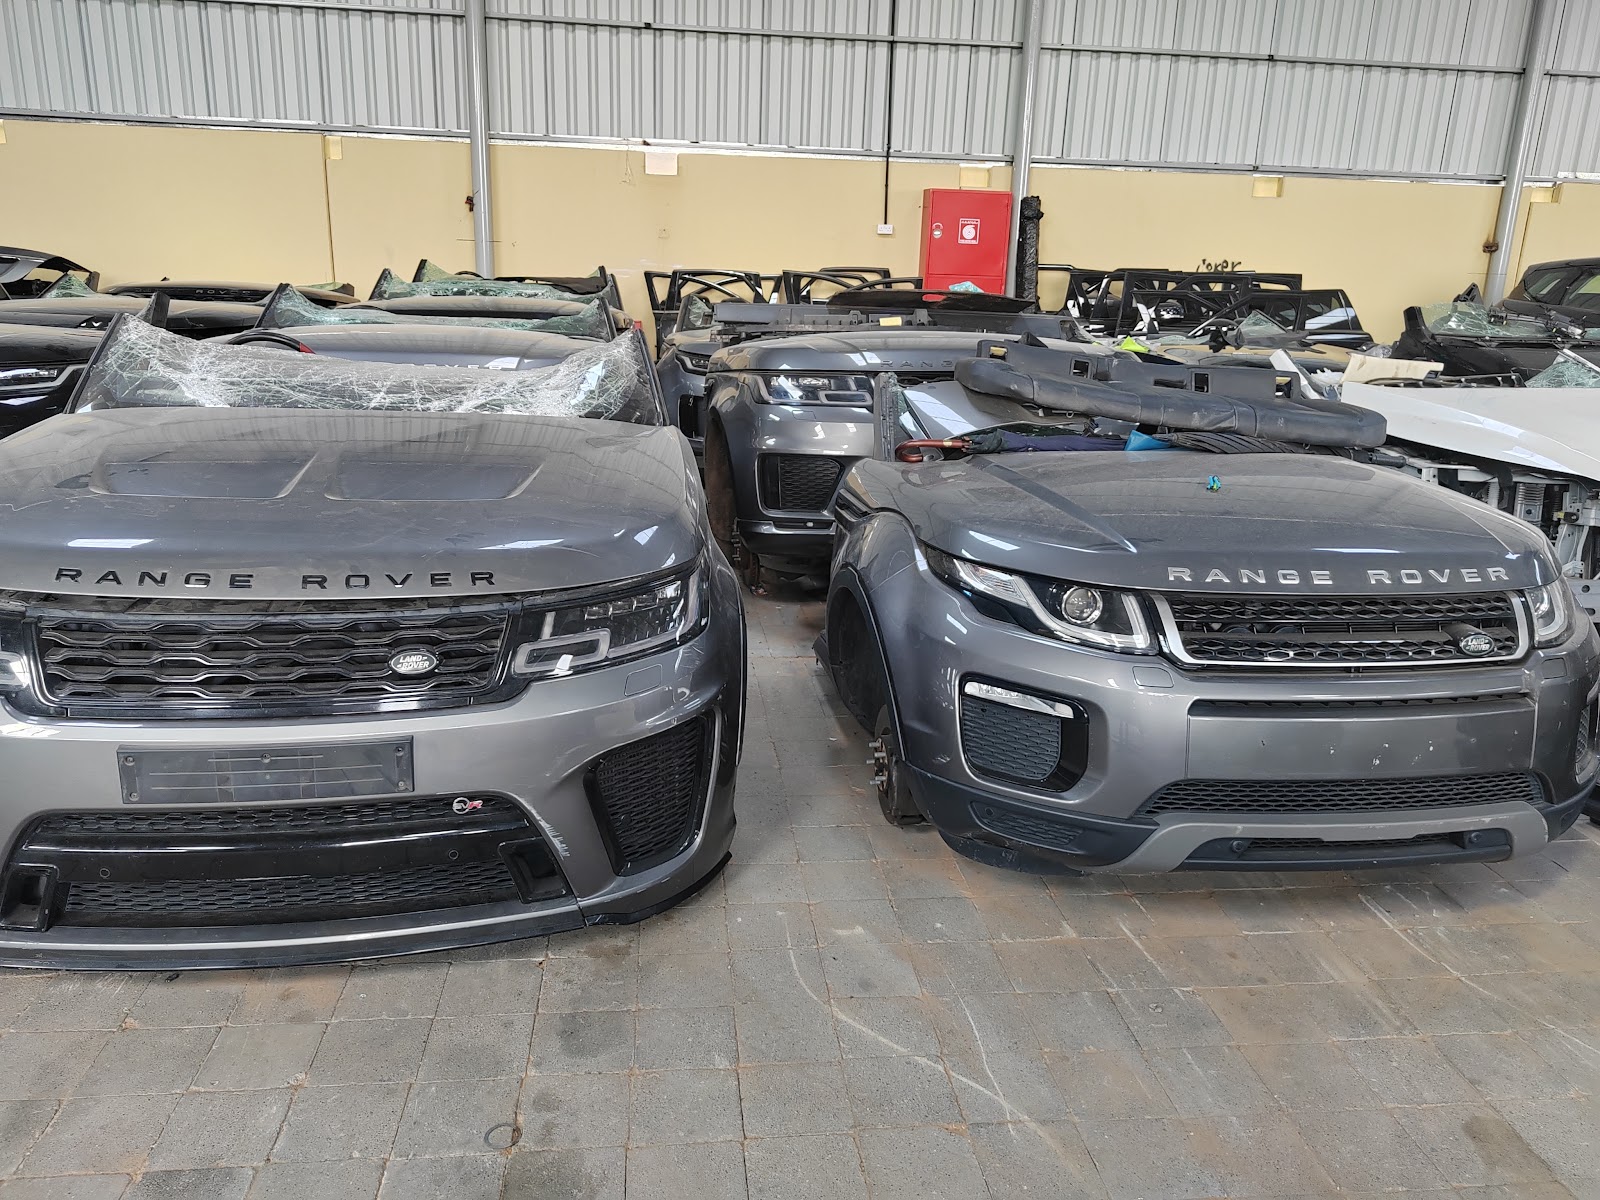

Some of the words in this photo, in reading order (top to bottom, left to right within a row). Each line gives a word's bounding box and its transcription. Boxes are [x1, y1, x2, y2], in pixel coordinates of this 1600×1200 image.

[881, 360, 954, 368] RANG
[55, 567, 254, 589] RANGE
[301, 571, 495, 590] ROVER
[1167, 566, 1333, 585] RANGE
[1367, 567, 1509, 585] ROVER
[1468, 638, 1485, 646] LAND
[400, 655, 423, 663] LAND
[401, 660, 430, 670] ROVER
